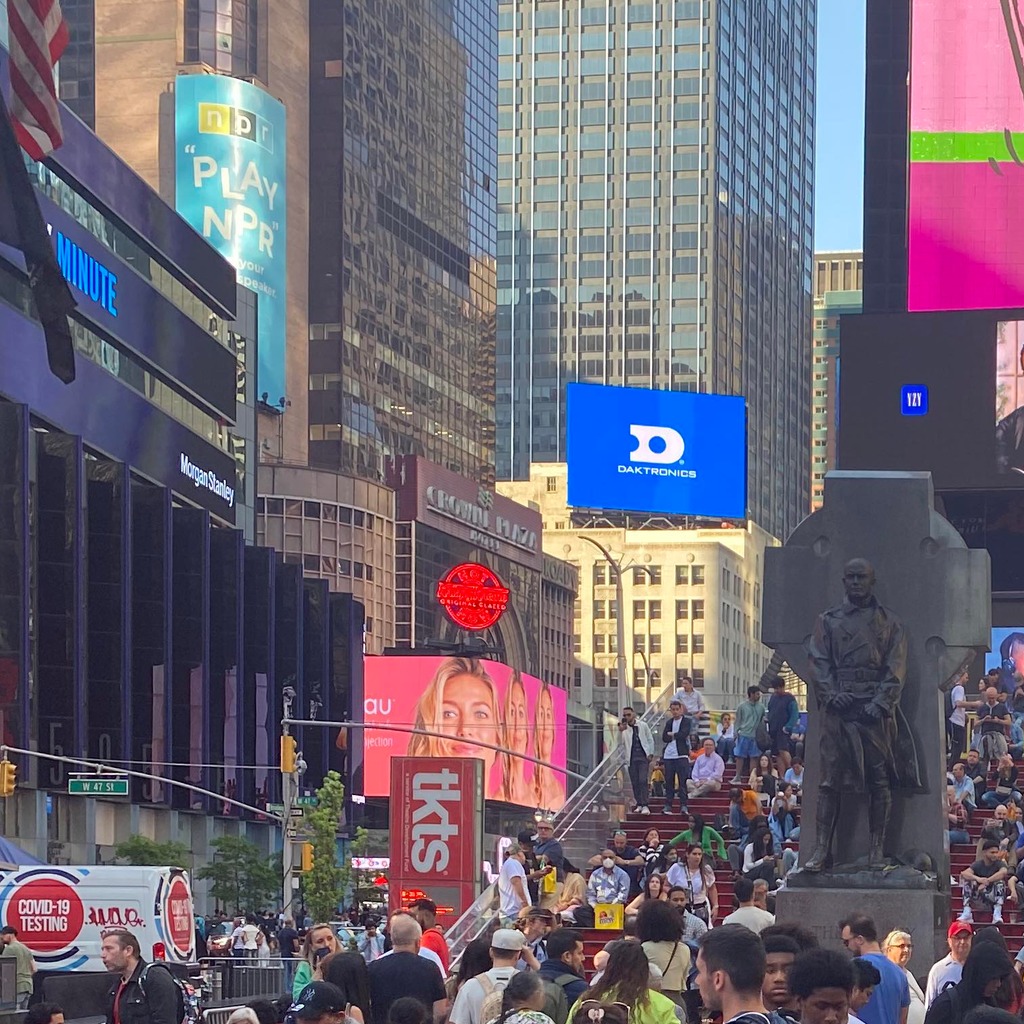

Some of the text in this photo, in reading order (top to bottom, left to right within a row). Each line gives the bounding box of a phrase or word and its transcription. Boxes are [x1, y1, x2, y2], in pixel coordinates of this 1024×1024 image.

[207, 110, 270, 138] npr
[57, 231, 118, 317] MINUTE
[239, 260, 265, 275] your
[907, 392, 922, 407] YZY
[617, 465, 697, 478] DAKTRONICS
[180, 453, 234, 507] Morgan Stanley
[82, 782, 90, 791] W
[93, 782, 102, 791] 47
[411, 768, 461, 874] tkts
[18, 899, 70, 915] COVID-19
[20, 916, 68, 932] TESTING
